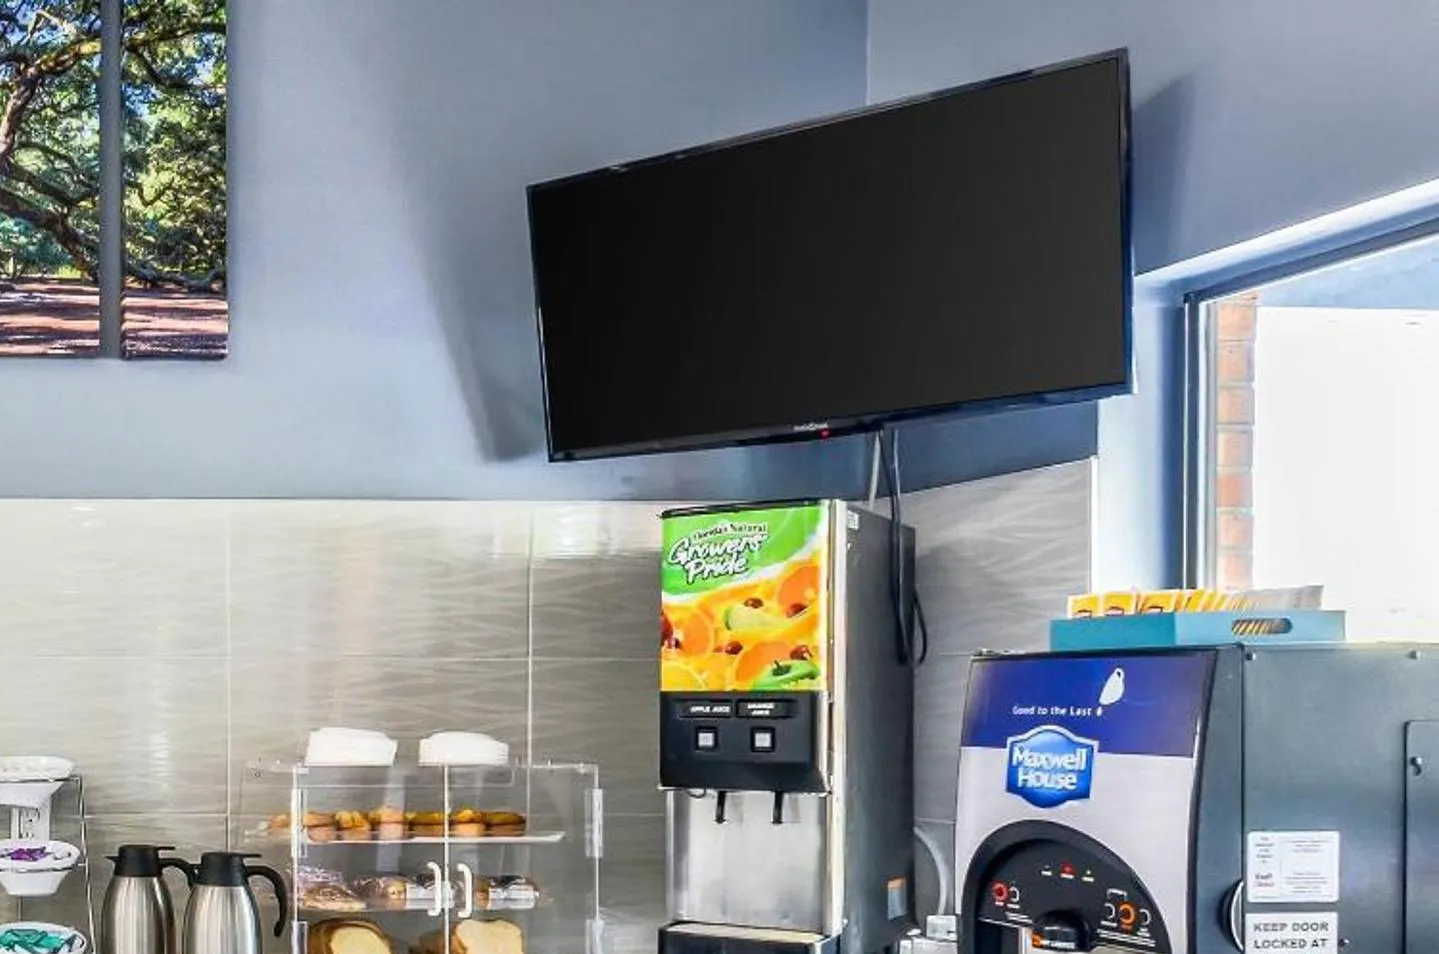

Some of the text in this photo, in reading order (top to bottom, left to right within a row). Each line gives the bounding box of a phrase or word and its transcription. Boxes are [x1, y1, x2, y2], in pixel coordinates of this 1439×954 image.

[730, 522, 767, 533] Natural
[685, 554, 748, 584] Pride
[1012, 705, 1093, 717] Good to the Last
[1012, 743, 1088, 771] Maxwell
[1017, 767, 1078, 790] House
[1253, 922, 1330, 932] KEEP DOOR
[1253, 939, 1328, 949] LOCKED AT
